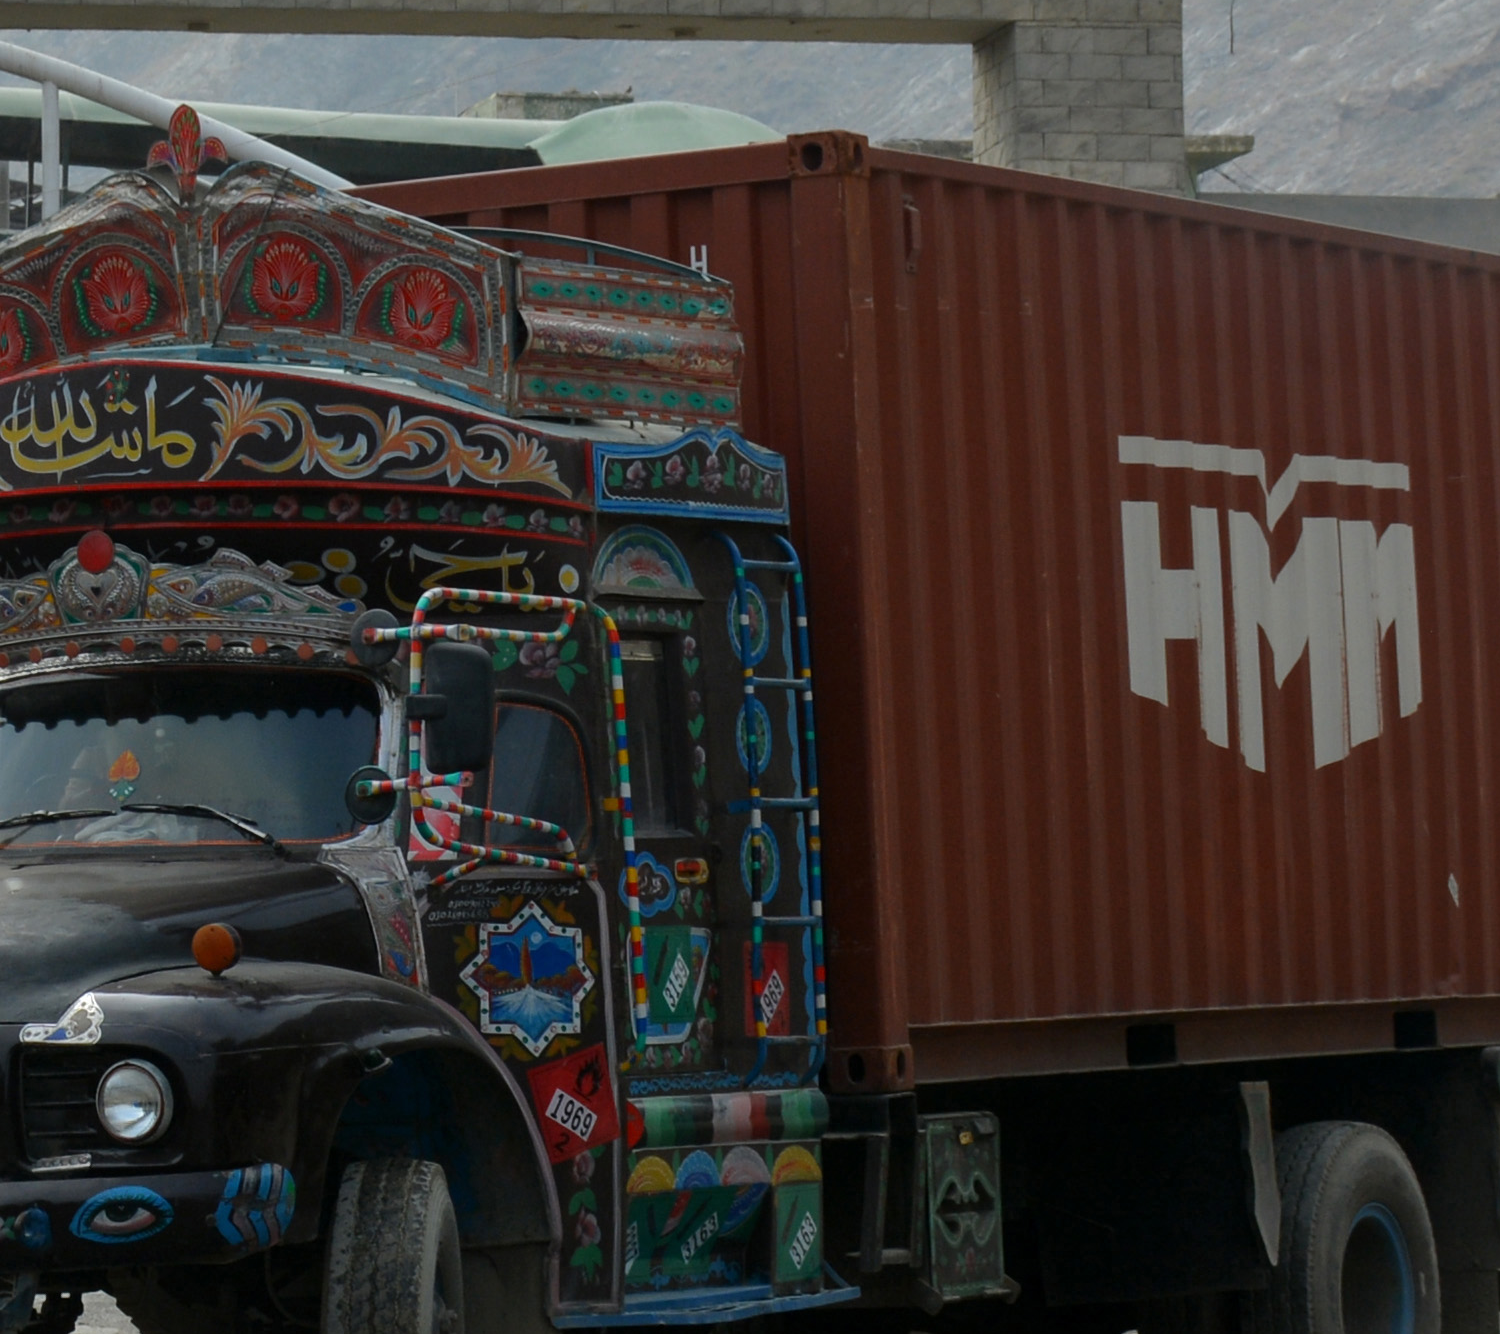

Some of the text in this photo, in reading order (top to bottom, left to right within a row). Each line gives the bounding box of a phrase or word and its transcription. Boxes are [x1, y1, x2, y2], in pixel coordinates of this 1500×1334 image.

[1120, 492, 1423, 773] HMM
[663, 958, 690, 1009] 3159
[550, 1093, 594, 1137] 1969
[553, 1132, 571, 1154] 2
[681, 1212, 718, 1261] 3163
[792, 1217, 817, 1267] 3163
